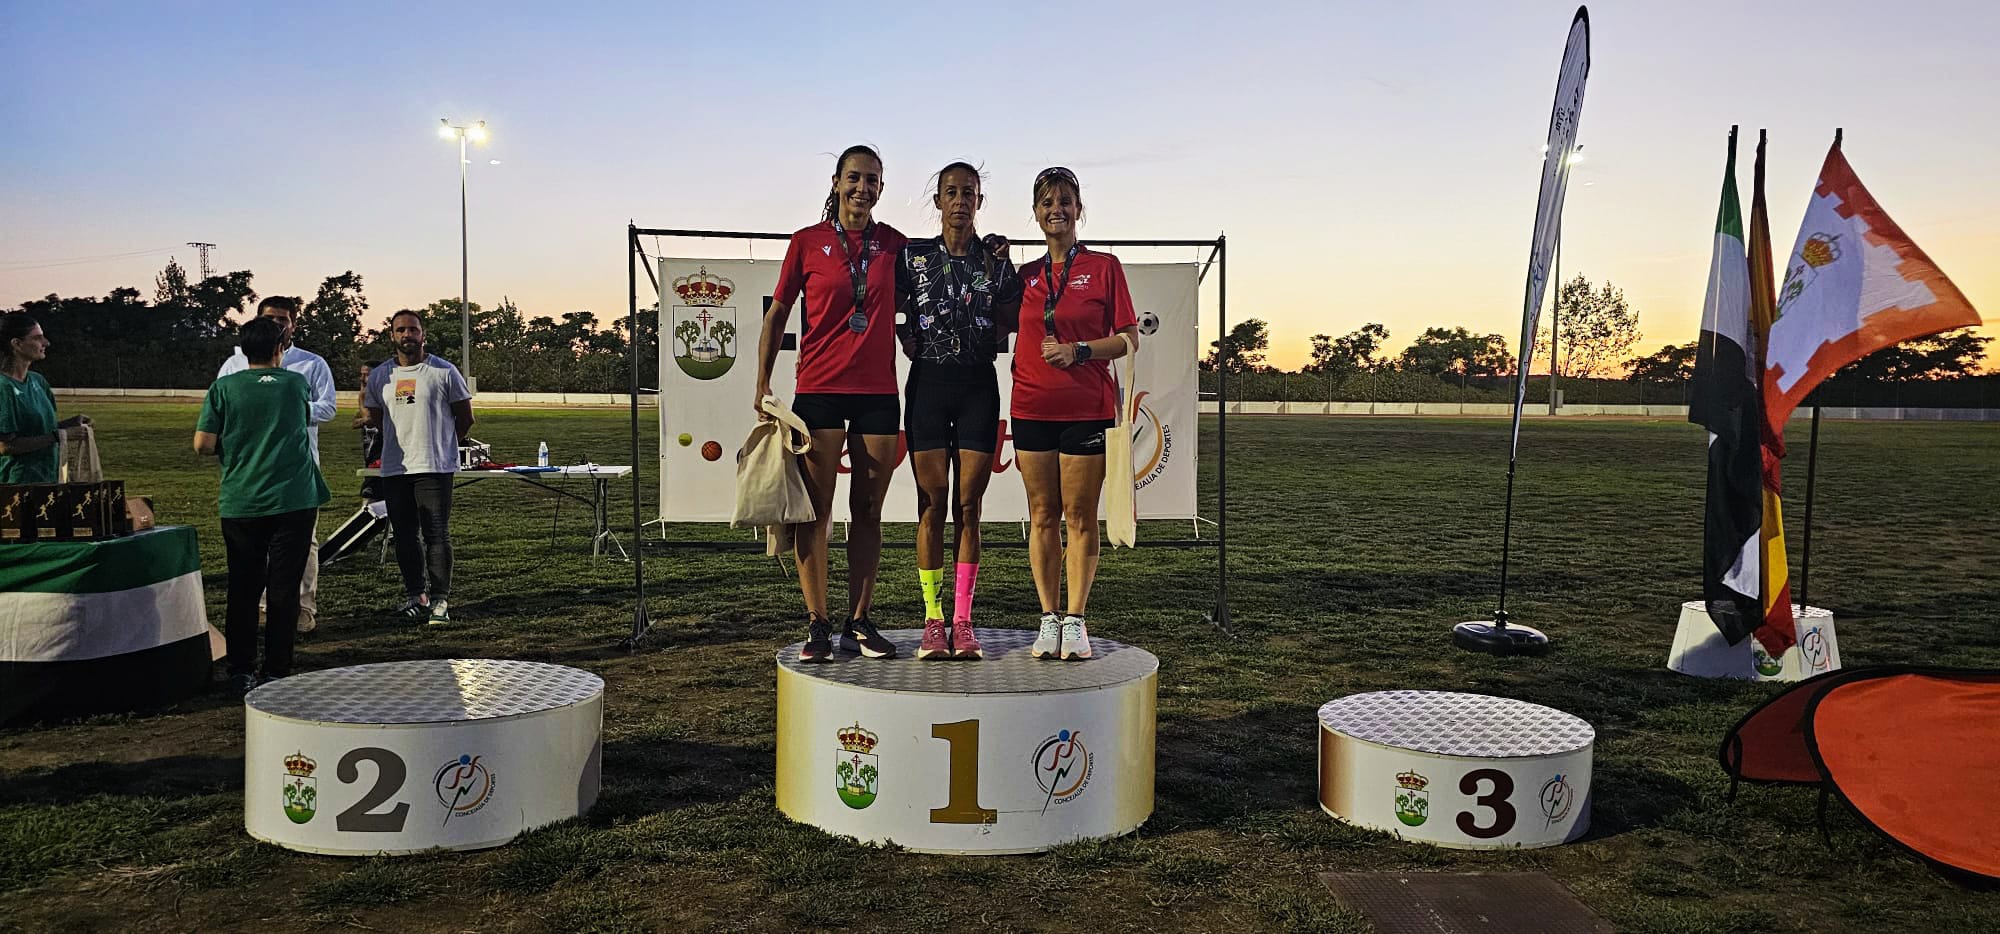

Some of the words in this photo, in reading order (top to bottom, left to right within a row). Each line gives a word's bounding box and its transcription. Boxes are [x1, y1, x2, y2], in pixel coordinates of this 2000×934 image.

[1135, 474, 1157, 490] EJALÍA
[1155, 463, 1165, 474] DE
[1161, 424, 1171, 463] DEPORTES
[336, 747, 410, 832] 2
[929, 719, 997, 823] 1
[1456, 769, 1516, 838] 3
